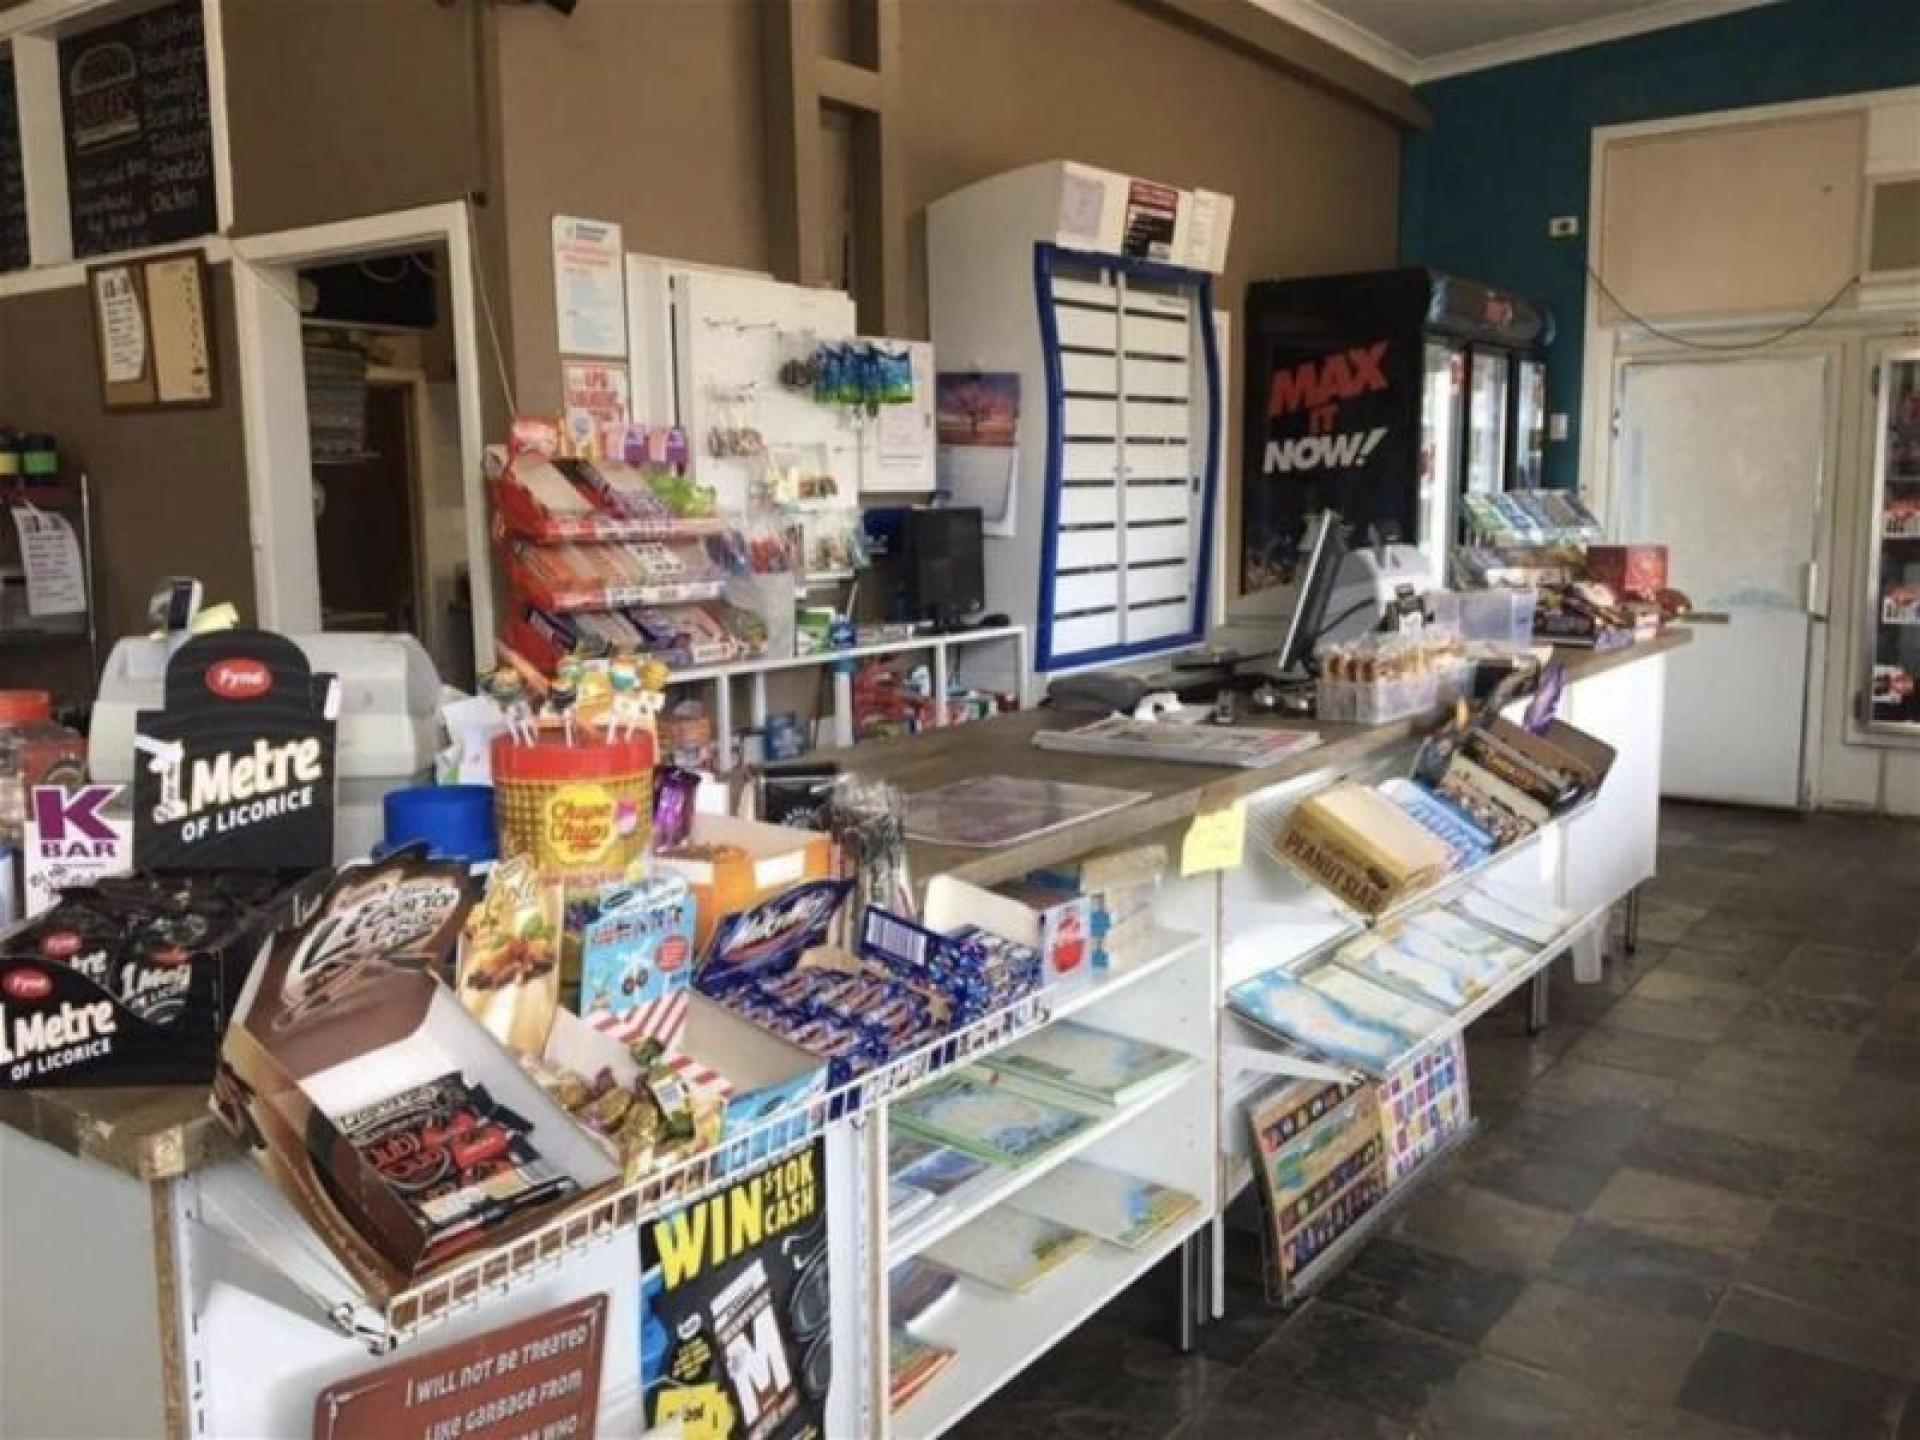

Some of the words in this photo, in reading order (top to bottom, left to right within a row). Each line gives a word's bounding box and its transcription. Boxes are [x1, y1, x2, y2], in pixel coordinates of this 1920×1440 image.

[1268, 343, 1388, 420] MAX
[1309, 404, 1338, 433] IT
[1263, 428, 1388, 474] NOW!
[192, 737, 322, 813] Metre
[36, 788, 119, 839] K
[182, 816, 210, 842] OF
[216, 786, 313, 833] LICORICE
[41, 842, 116, 857] BAR
[15, 1001, 116, 1057] Metre
[12, 1061, 31, 1080] OF
[38, 1037, 111, 1073] LICORICE
[655, 1178, 763, 1291] WIN
[765, 1186, 815, 1236] CASH
[405, 1377, 414, 1407] I
[417, 1369, 457, 1403] WILL
[460, 1357, 496, 1388] NOT
[496, 1349, 519, 1376] BE
[522, 1323, 588, 1364] TREATED
[465, 1386, 536, 1432] GARBAGE
[539, 1368, 582, 1402] FROM
